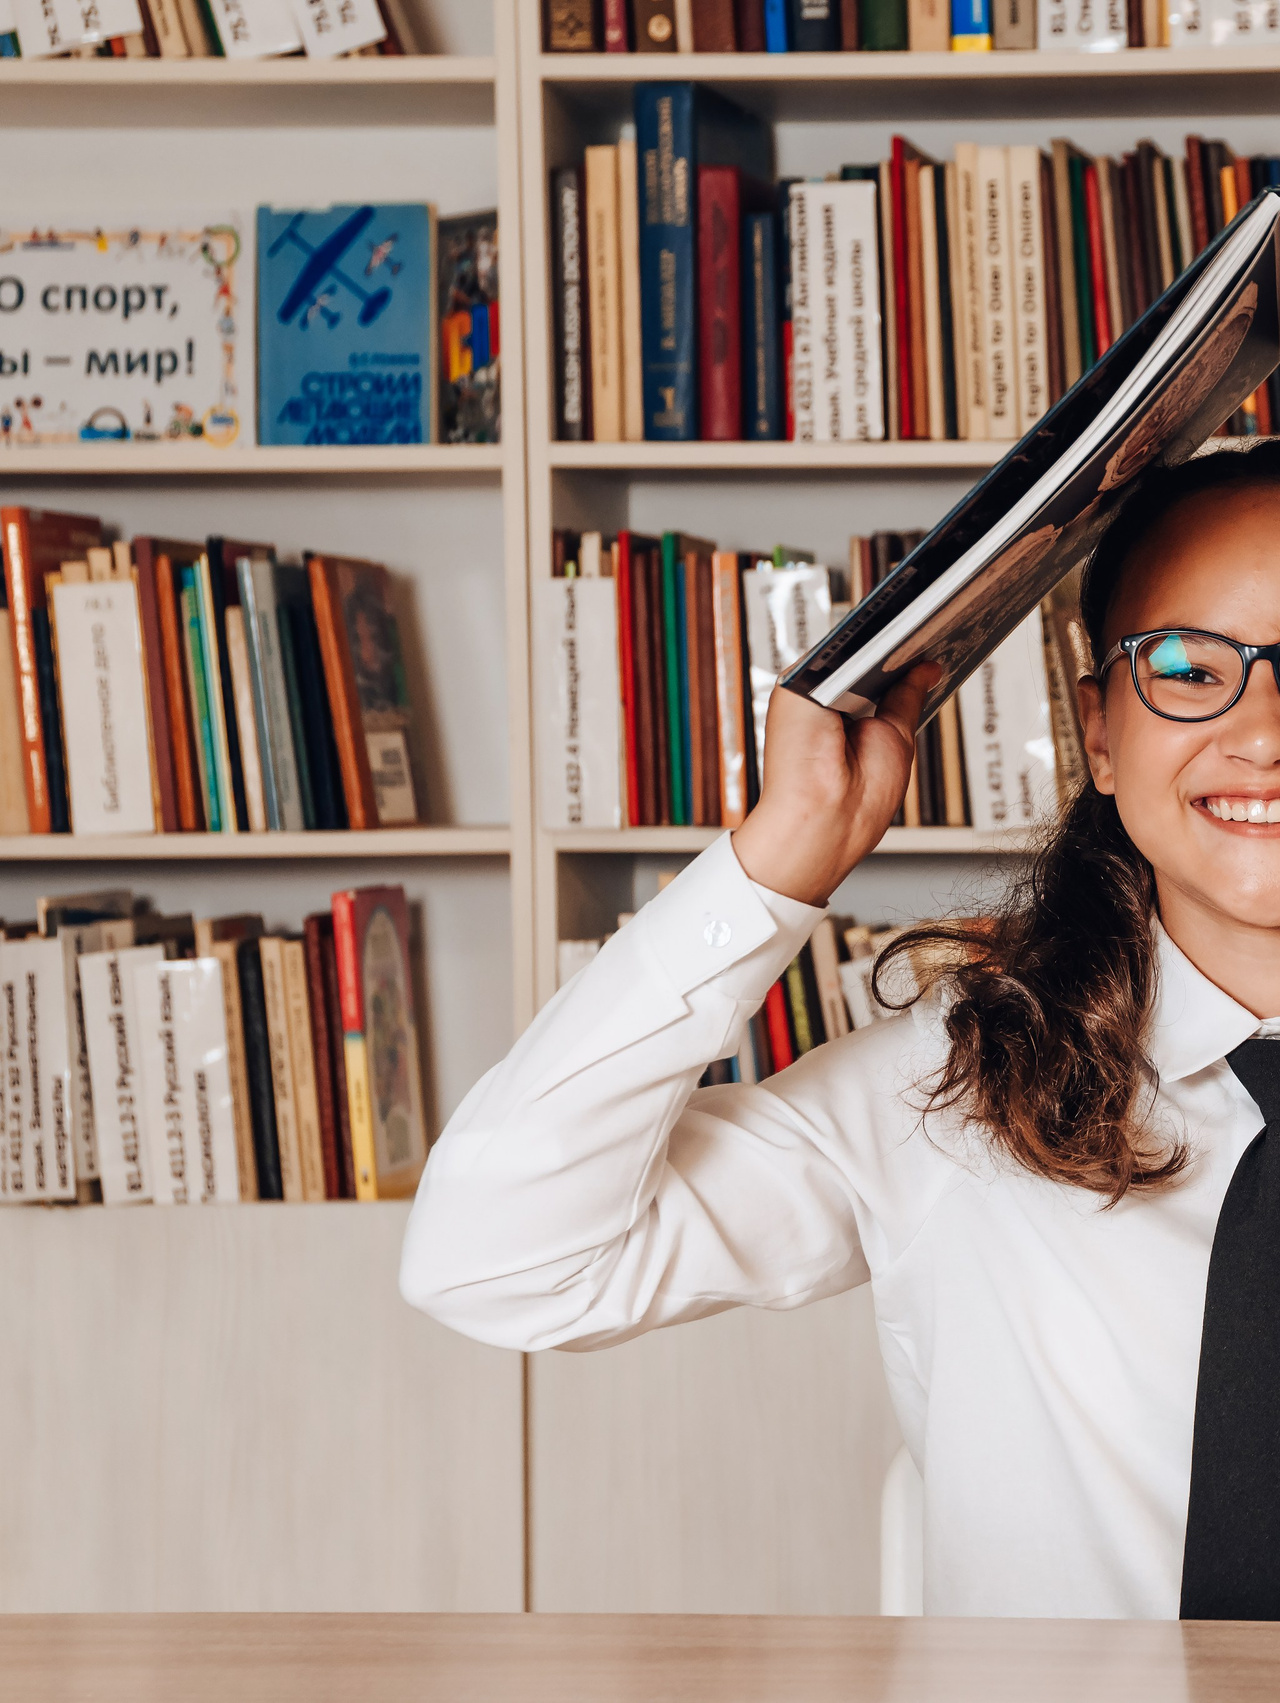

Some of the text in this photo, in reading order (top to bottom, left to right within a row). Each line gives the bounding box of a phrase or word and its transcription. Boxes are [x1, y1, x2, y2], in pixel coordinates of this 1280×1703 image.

[822, 204, 838, 289] издания
[985, 178, 1002, 258] Children
[1019, 179, 1035, 259] Children
[0, 275, 179, 322] О спорт,
[850, 239, 864, 309] школы
[988, 264, 1002, 314] Older
[1021, 265, 1037, 315] Older
[0, 350, 30, 376] ы
[85, 338, 194, 388] мир!
[822, 294, 839, 381] Учебные
[847, 315, 868, 398] средней
[988, 350, 1008, 419] English
[1023, 352, 1041, 418] English
[560, 638, 581, 739] Немецкий
[108, 1013, 134, 1091] Русский
[157, 1029, 180, 1107] Русский
